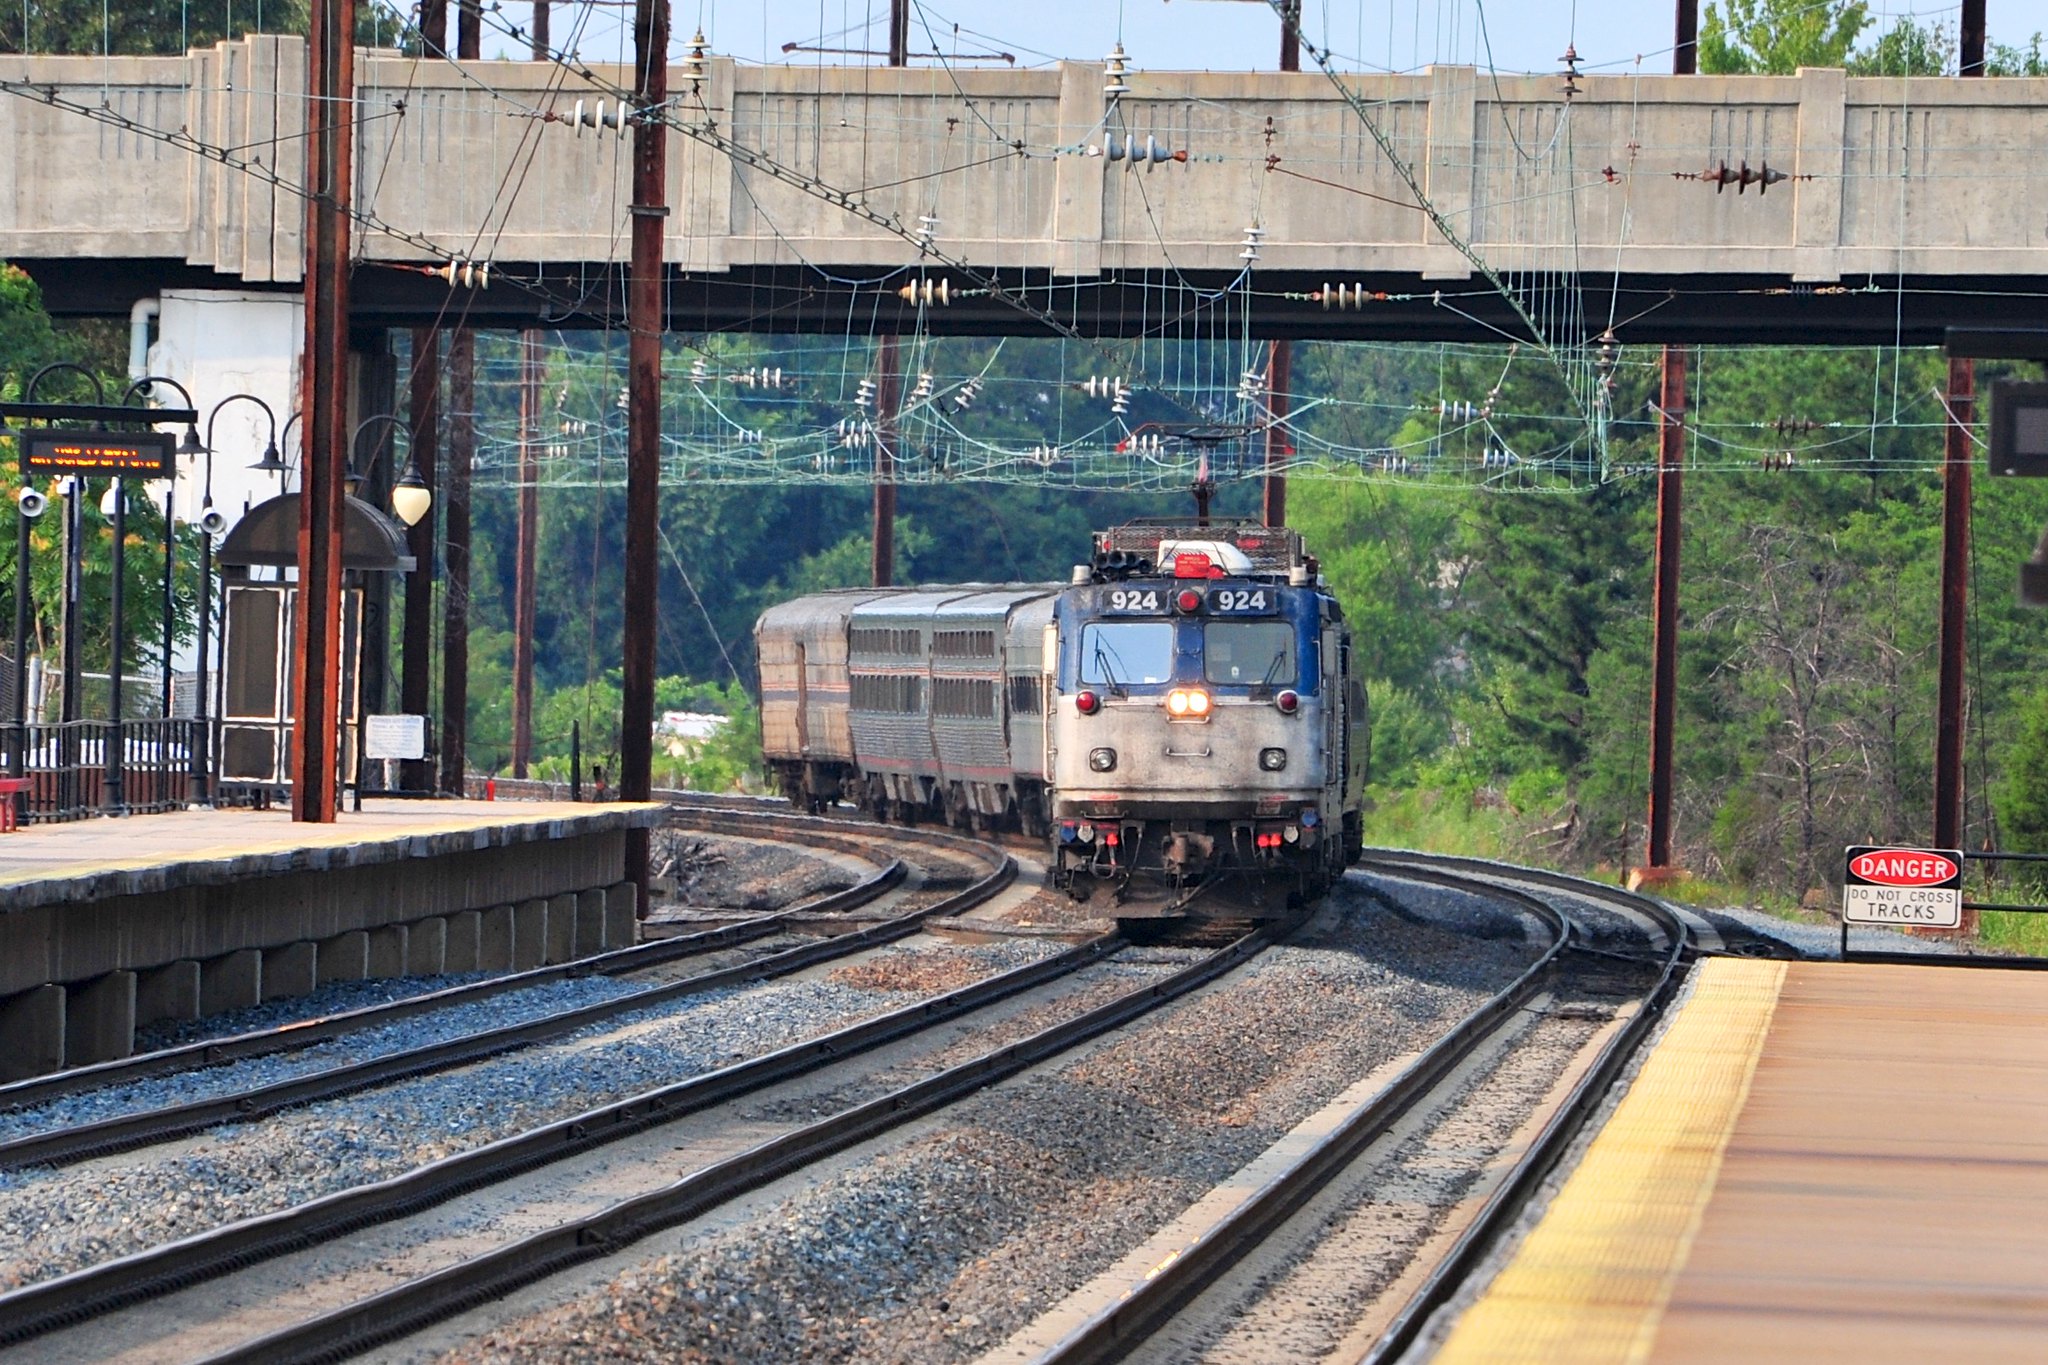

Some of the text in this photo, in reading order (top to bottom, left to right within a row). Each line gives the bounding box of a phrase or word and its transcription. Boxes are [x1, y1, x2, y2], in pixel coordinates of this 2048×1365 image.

[1111, 590, 1158, 610] 924
[1219, 590, 1266, 610] 924
[1860, 857, 1948, 879] DANGER
[1851, 888, 1953, 903] DO NOT CROSS
[1867, 902, 1936, 920] TRACKS
